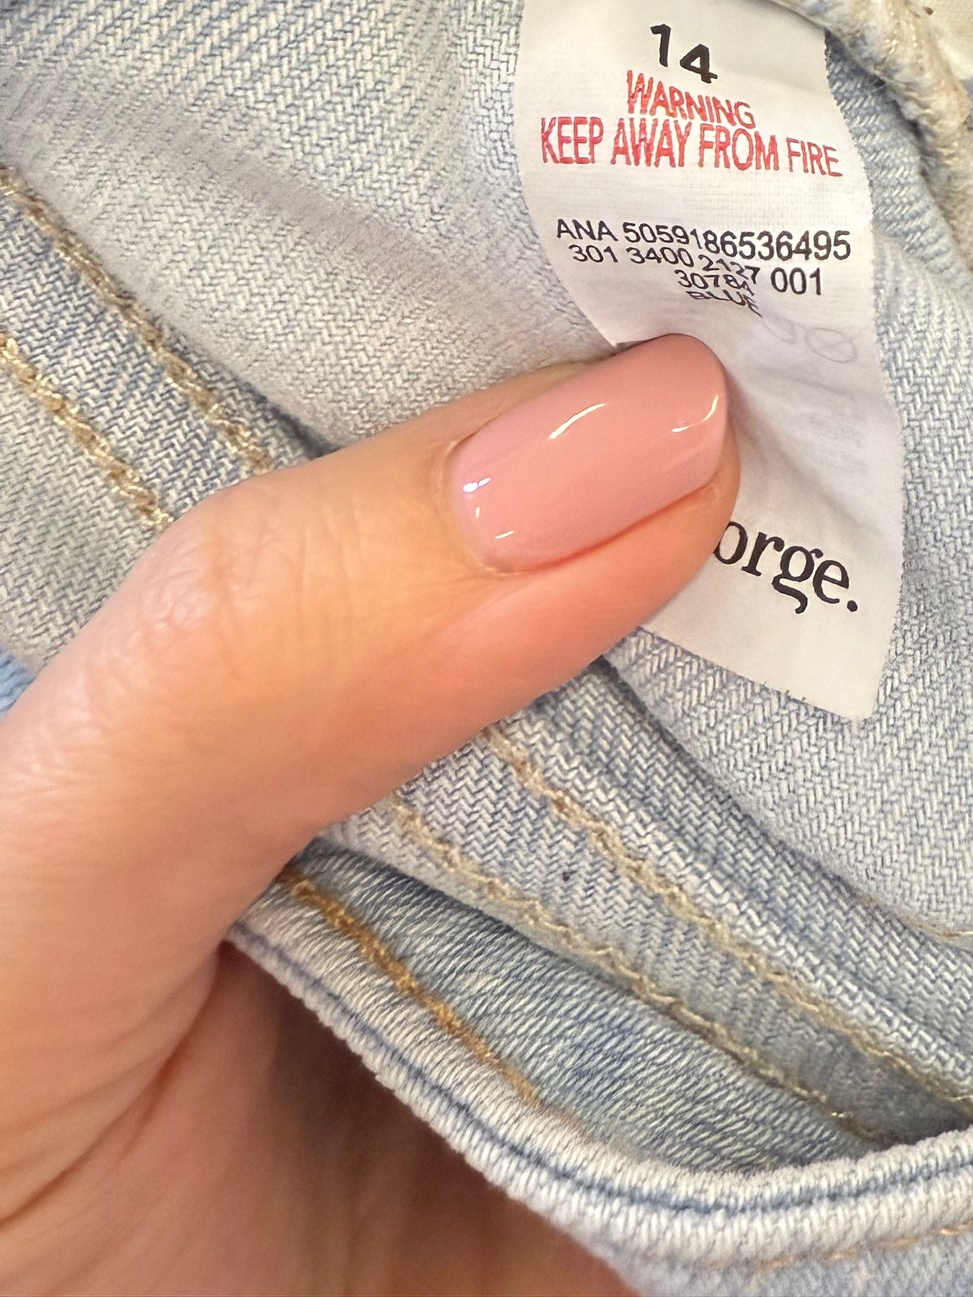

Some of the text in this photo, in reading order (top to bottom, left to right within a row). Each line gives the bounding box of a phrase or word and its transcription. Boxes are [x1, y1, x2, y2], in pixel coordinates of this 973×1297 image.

[650, 23, 718, 84] 14
[627, 69, 755, 129] WARNING
[540, 116, 843, 177] KEEP AWAY FROM FIRE
[556, 218, 852, 262] ANA 5059186536495
[568, 244, 822, 296] 301 3400 2127 001
[685, 289, 764, 319] BLUE
[712, 520, 858, 615] orge.
